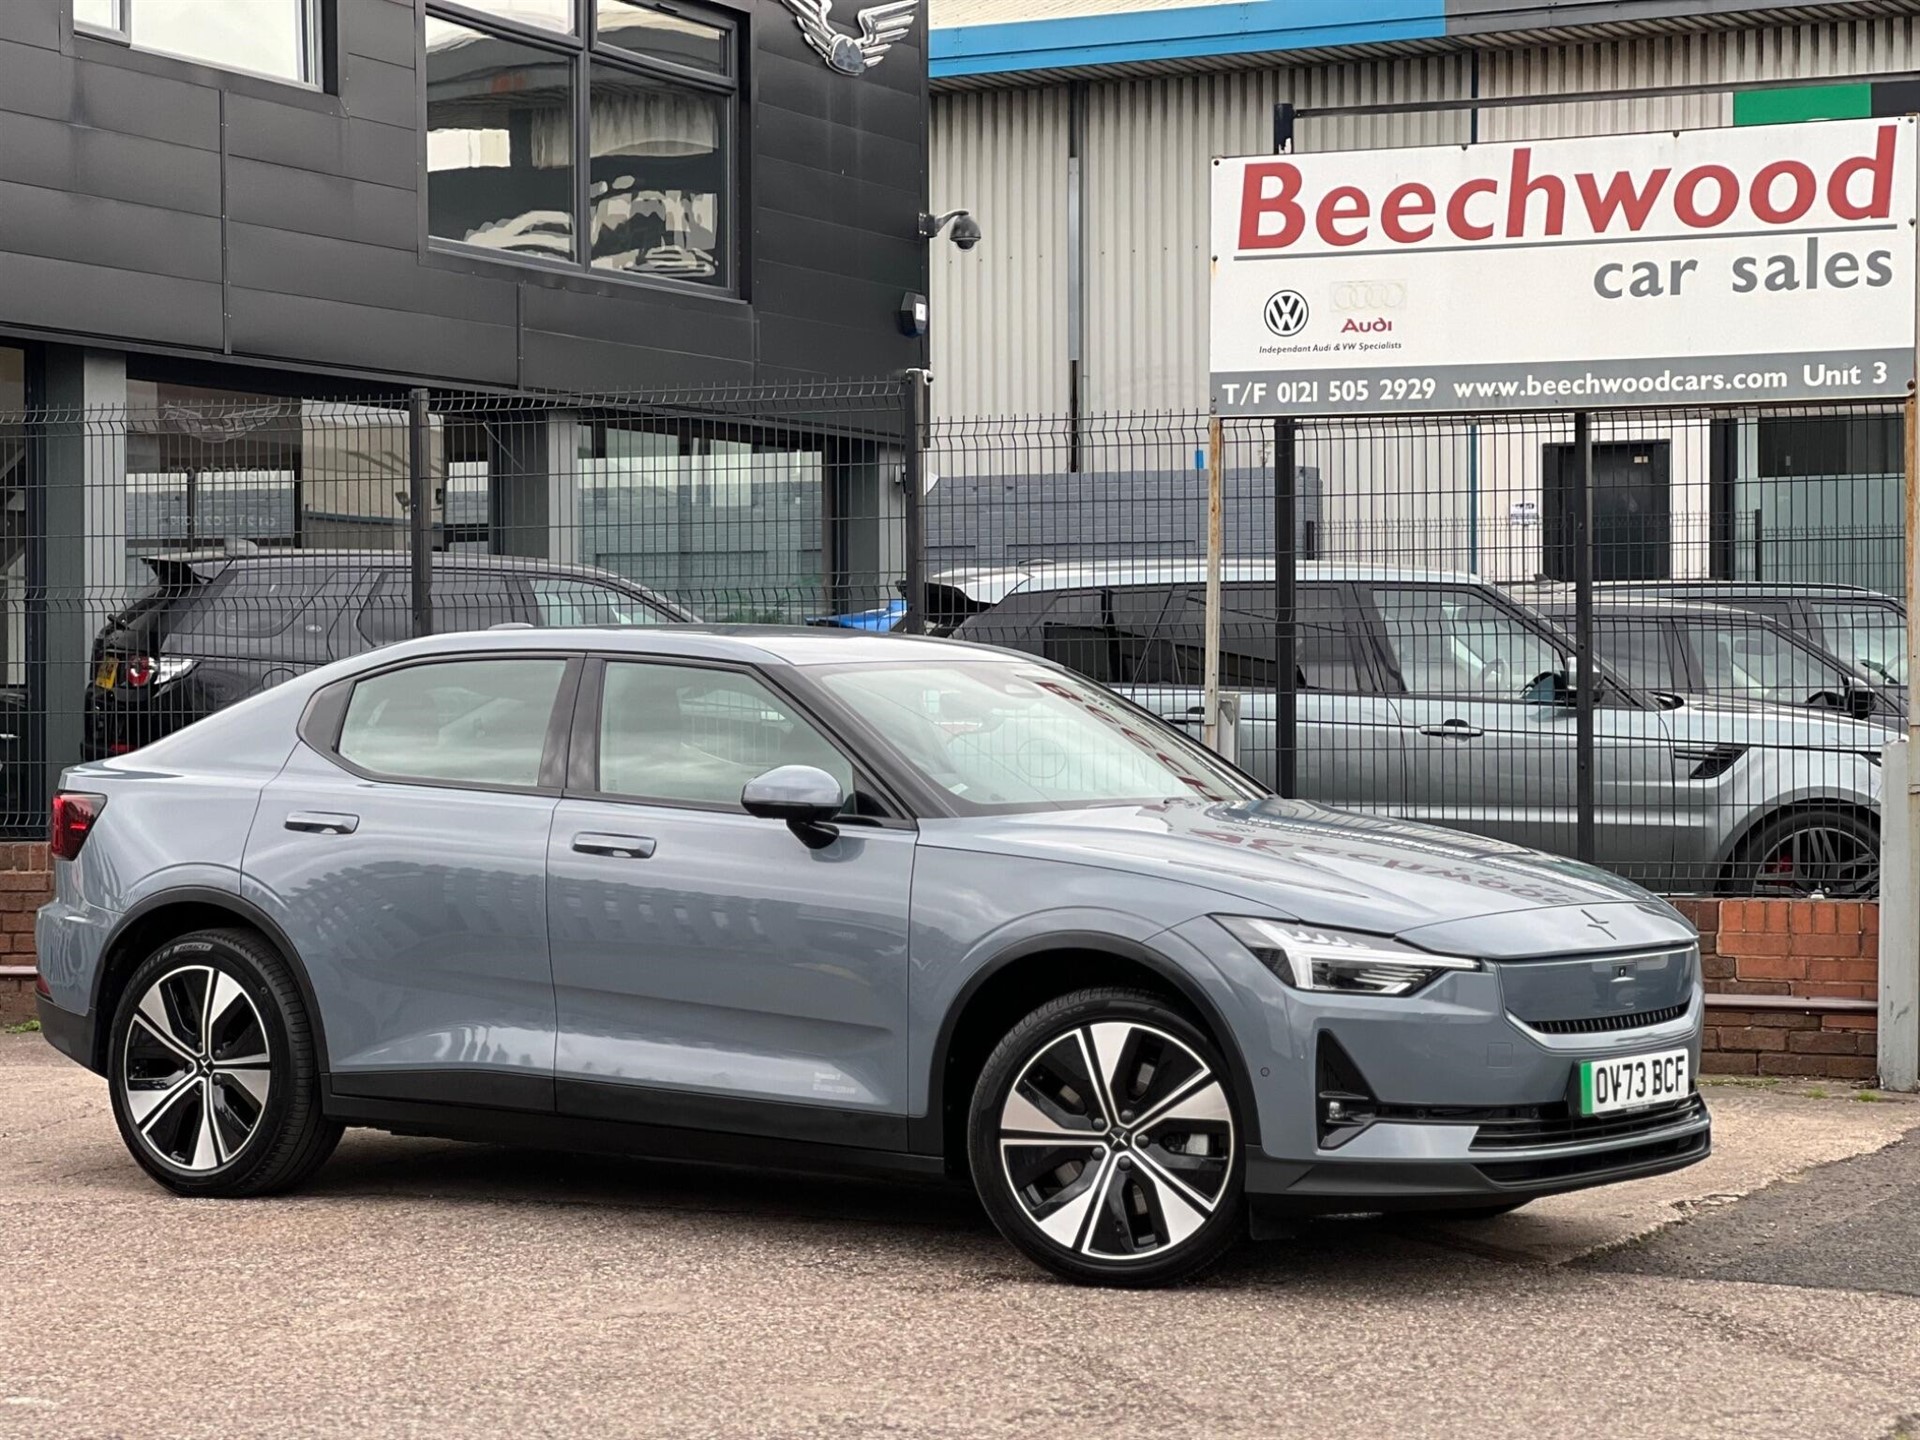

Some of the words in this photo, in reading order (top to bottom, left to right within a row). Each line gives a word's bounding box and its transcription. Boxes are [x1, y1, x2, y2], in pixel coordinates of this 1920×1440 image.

[1237, 125, 1897, 250] Beechwood
[1593, 255, 1698, 299] car
[1731, 237, 1893, 293] sales
[1258, 345, 1311, 356] Independant
[1312, 343, 1332, 353] Audi
[1333, 342, 1341, 351] &
[1342, 342, 1357, 351] VW
[1358, 340, 1402, 352] Specialists
[1340, 317, 1393, 334] Audi
[1222, 381, 1267, 406] T/F
[1276, 381, 1318, 403] 0121
[1328, 379, 1369, 402] 505
[1379, 378, 1436, 401] 2929
[1453, 369, 1787, 398] www.beechwoodcars.com
[1803, 362, 1861, 387] Unit
[1872, 361, 1887, 384] 3
[1596, 1062, 1646, 1104] OV73
[1652, 1054, 1685, 1096] BCF
